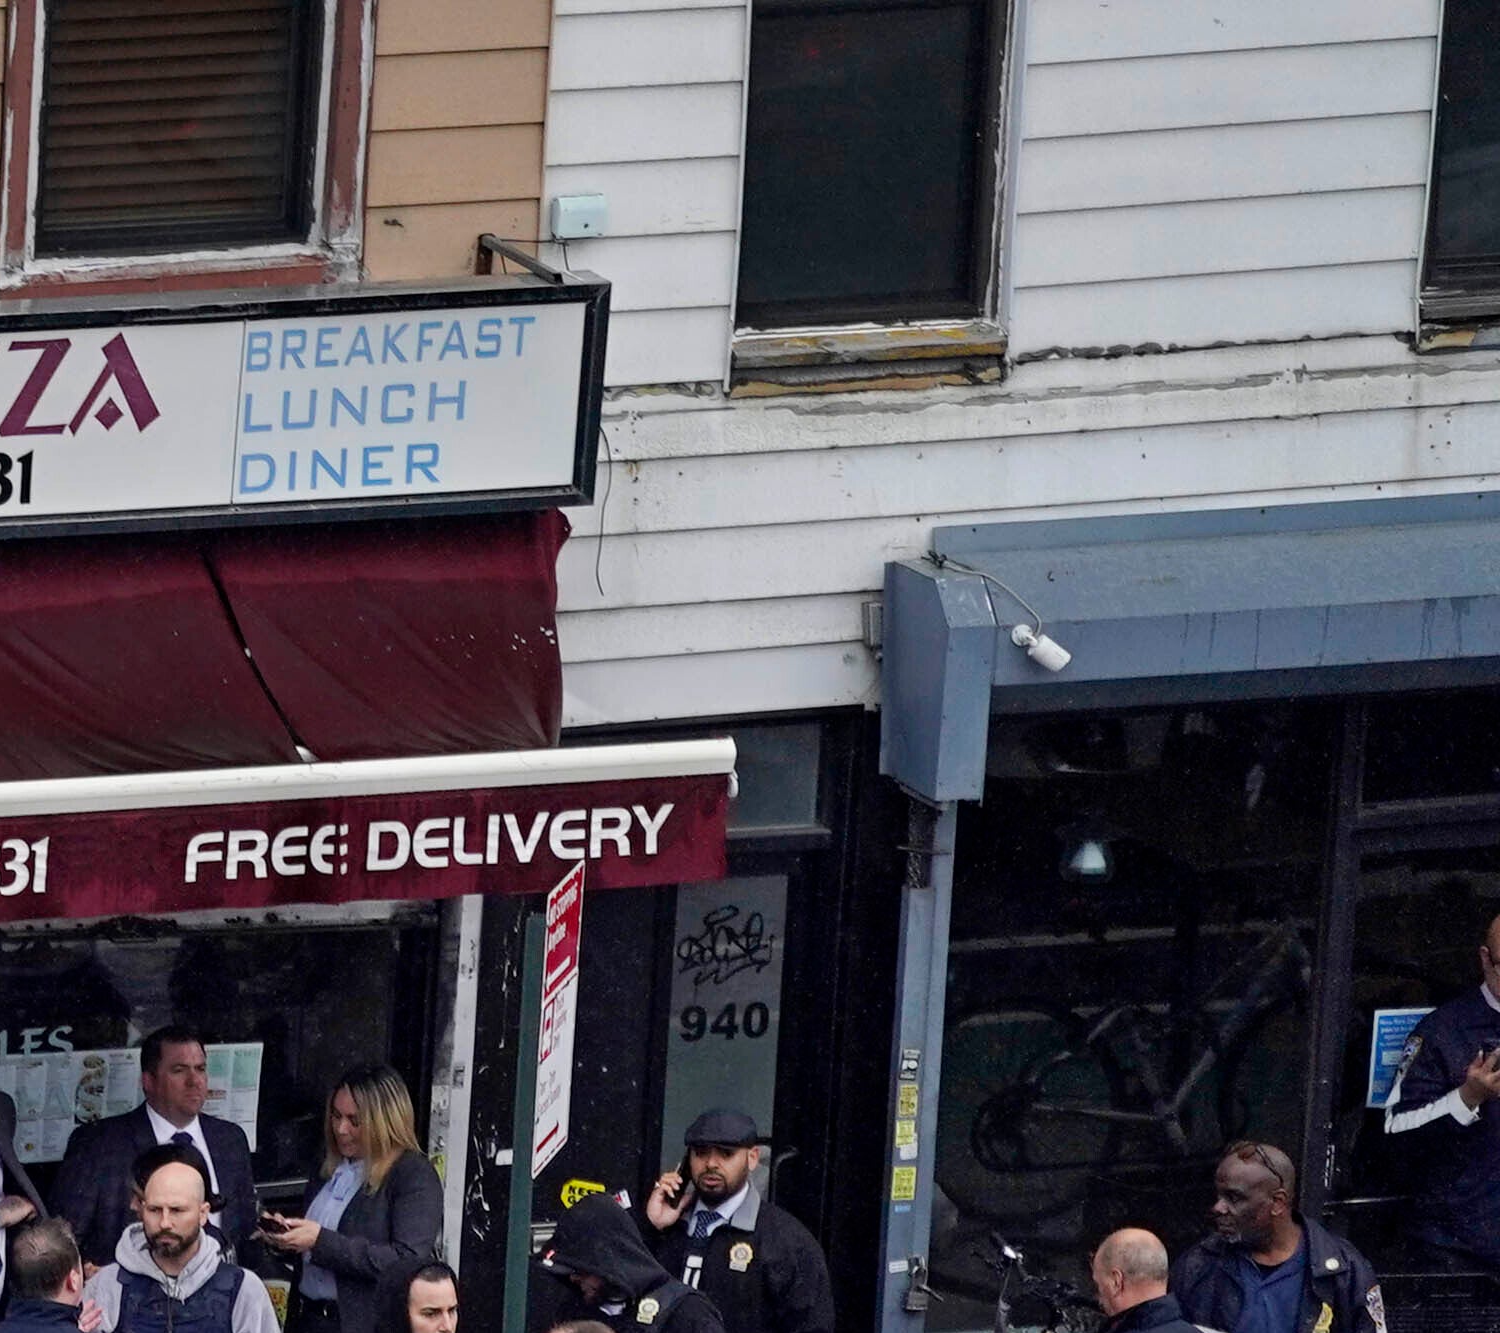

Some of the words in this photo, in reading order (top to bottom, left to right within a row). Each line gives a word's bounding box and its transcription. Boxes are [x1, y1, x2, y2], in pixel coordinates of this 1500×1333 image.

[244, 315, 537, 373] BREAKFAST
[241, 379, 466, 434] LUNCH
[238, 443, 441, 495] DINER
[185, 823, 346, 883] FREE
[367, 802, 675, 868] DELIVERY
[679, 1000, 769, 1043] 940
